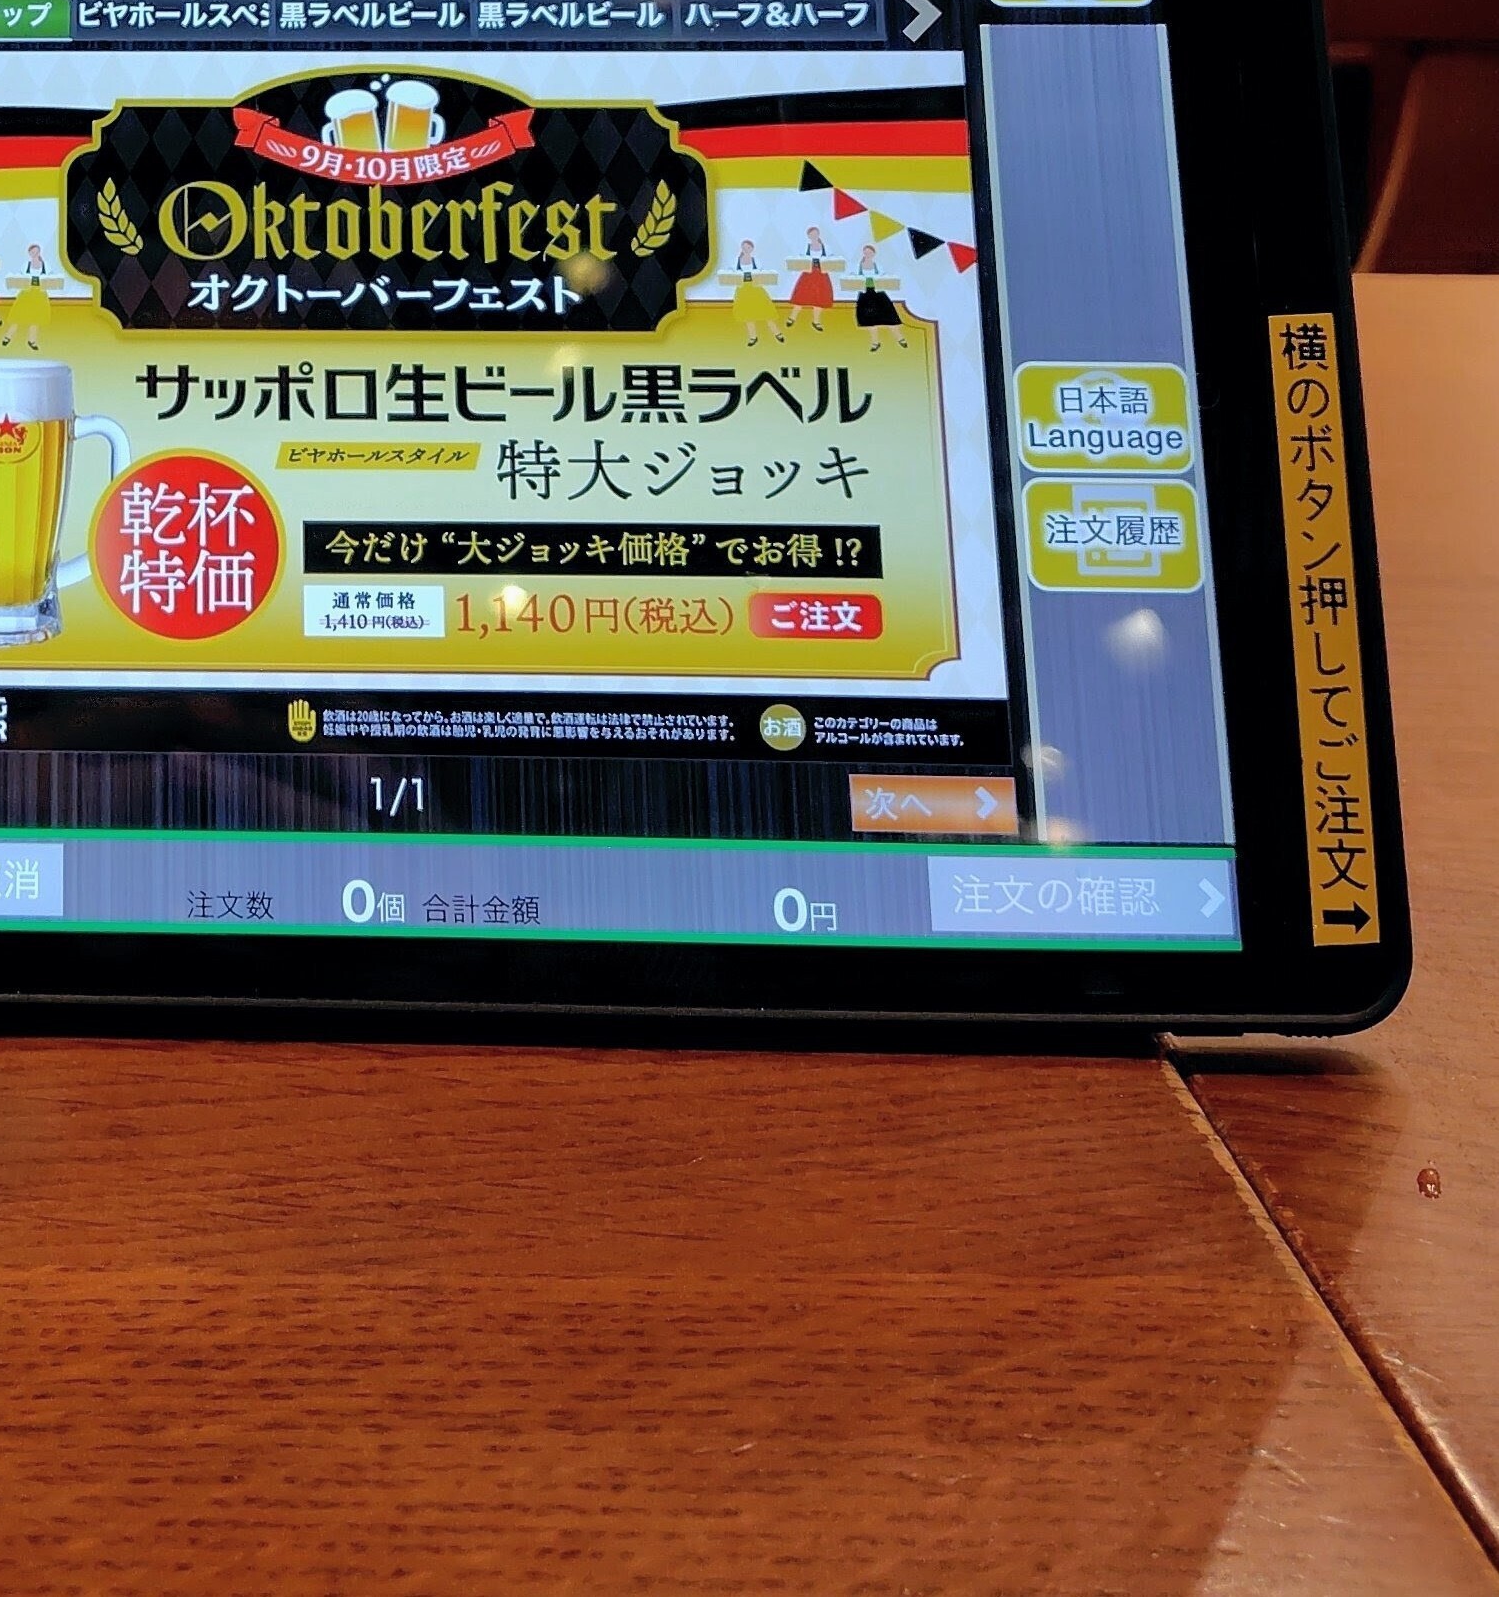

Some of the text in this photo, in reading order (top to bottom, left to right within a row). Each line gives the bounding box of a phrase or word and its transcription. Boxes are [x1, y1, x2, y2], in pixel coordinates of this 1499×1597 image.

[278, 1, 465, 30] 黒ラベルビール
[477, 1, 664, 30] 黒ラベルビール
[684, 2, 870, 29] ハーフ&ハーフ
[157, 179, 618, 264] Oktoberfest
[186, 273, 583, 315] オクトーバーフェスト
[135, 361, 873, 425] サッポロ生ビール黒ラベル
[1058, 386, 1151, 416] 日本語
[286, 446, 471, 467] ビヤホールスタイル
[1027, 421, 1185, 459] Language
[496, 437, 871, 502] 特大ジョッキ
[118, 480, 255, 547] 乾杯
[1045, 514, 1183, 549] 注文履歴
[118, 548, 255, 616] 特価
[331, 591, 416, 611] 通常価格
[455, 592, 735, 640] 1,140円(税込)
[770, 599, 863, 635] ご注文
[1277, 321, 1370, 893] 横のボタン押してご注文
[762, 716, 804, 738] お酒
[813, 716, 938, 732] このカテゴリーの商品は
[369, 776, 426, 817] 1/1
[864, 786, 933, 822] 次へ
[186, 890, 275, 922] 注文数
[422, 893, 542, 927] 合計金額
[952, 873, 1161, 917] 注文の確認
